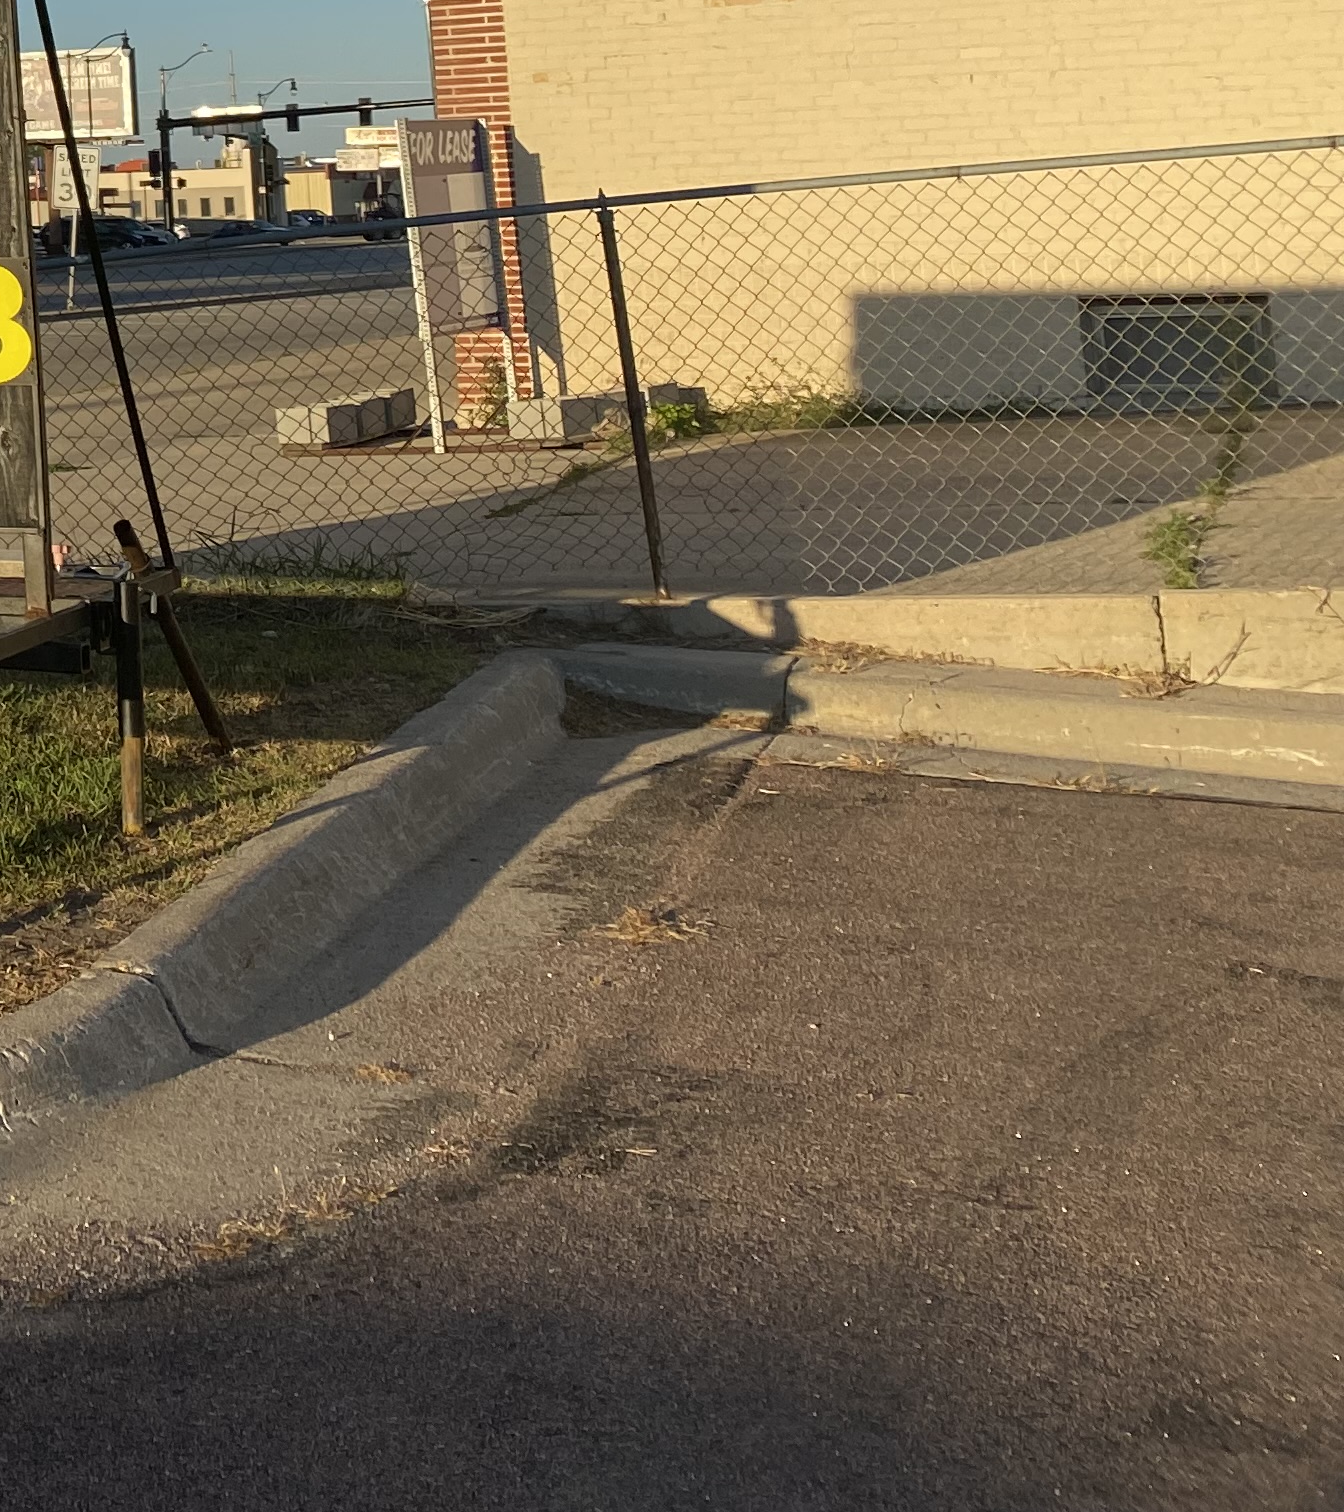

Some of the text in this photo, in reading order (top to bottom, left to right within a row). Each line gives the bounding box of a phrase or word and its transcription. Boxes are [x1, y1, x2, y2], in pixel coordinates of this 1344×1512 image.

[410, 131, 435, 166] FOR
[438, 129, 476, 164] LEASE
[58, 152, 96, 164] SED
[61, 167, 92, 178] LIT
